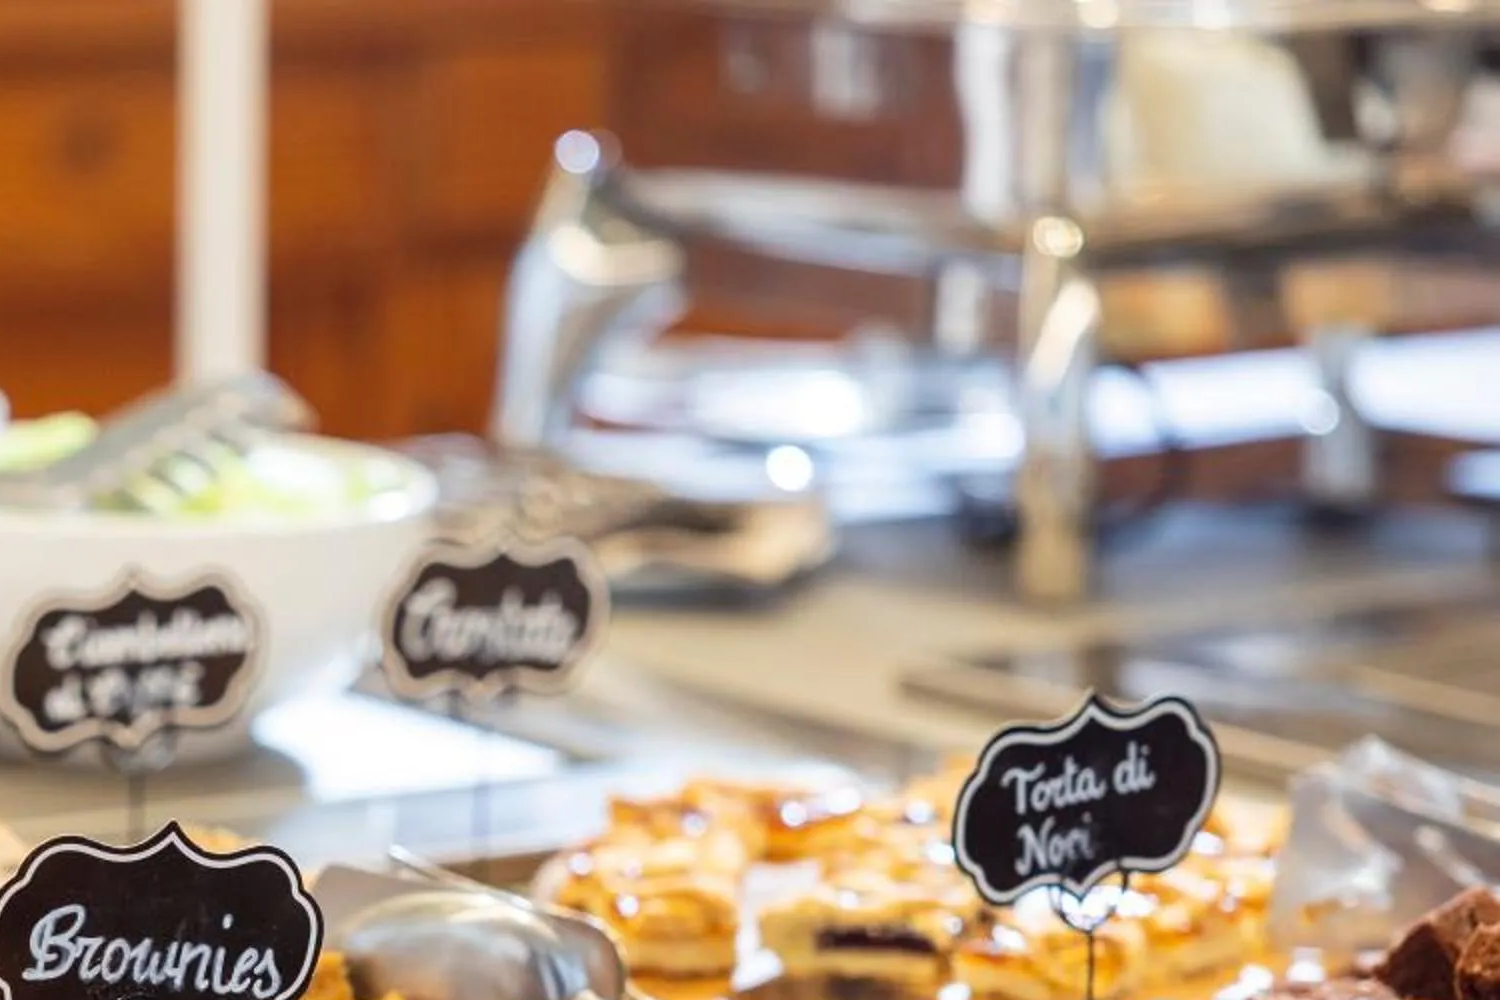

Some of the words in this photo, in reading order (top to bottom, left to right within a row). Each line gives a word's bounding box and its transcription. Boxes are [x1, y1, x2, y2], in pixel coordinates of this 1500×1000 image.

[1001, 755, 1106, 815] Torta
[1111, 741, 1157, 795] di
[22, 904, 282, 999] Brownies
